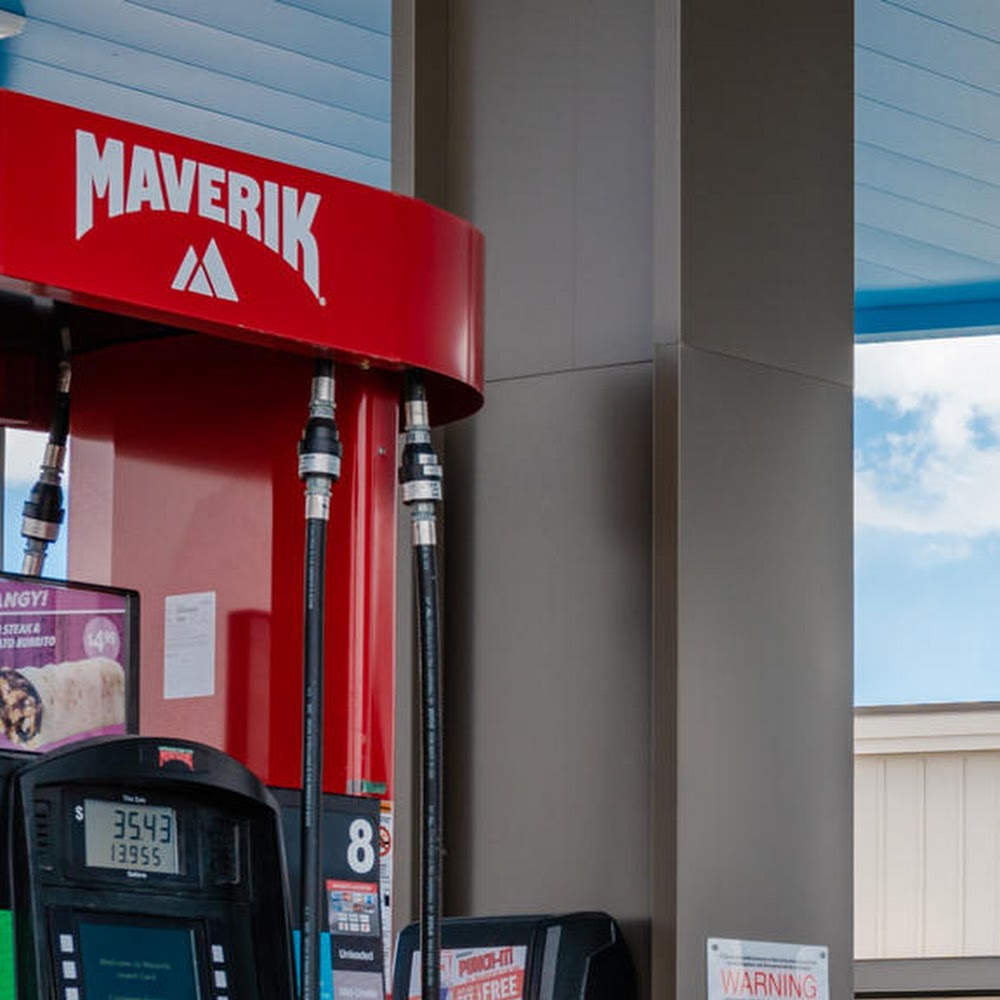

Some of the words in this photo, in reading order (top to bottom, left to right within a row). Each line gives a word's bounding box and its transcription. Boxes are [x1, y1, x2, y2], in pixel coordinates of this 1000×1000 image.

[75, 129, 324, 305] MAVERIK
[0, 590, 49, 609] NGY!
[75, 805, 84, 821] $
[346, 818, 375, 874] 8
[721, 970, 817, 999] WARNING
